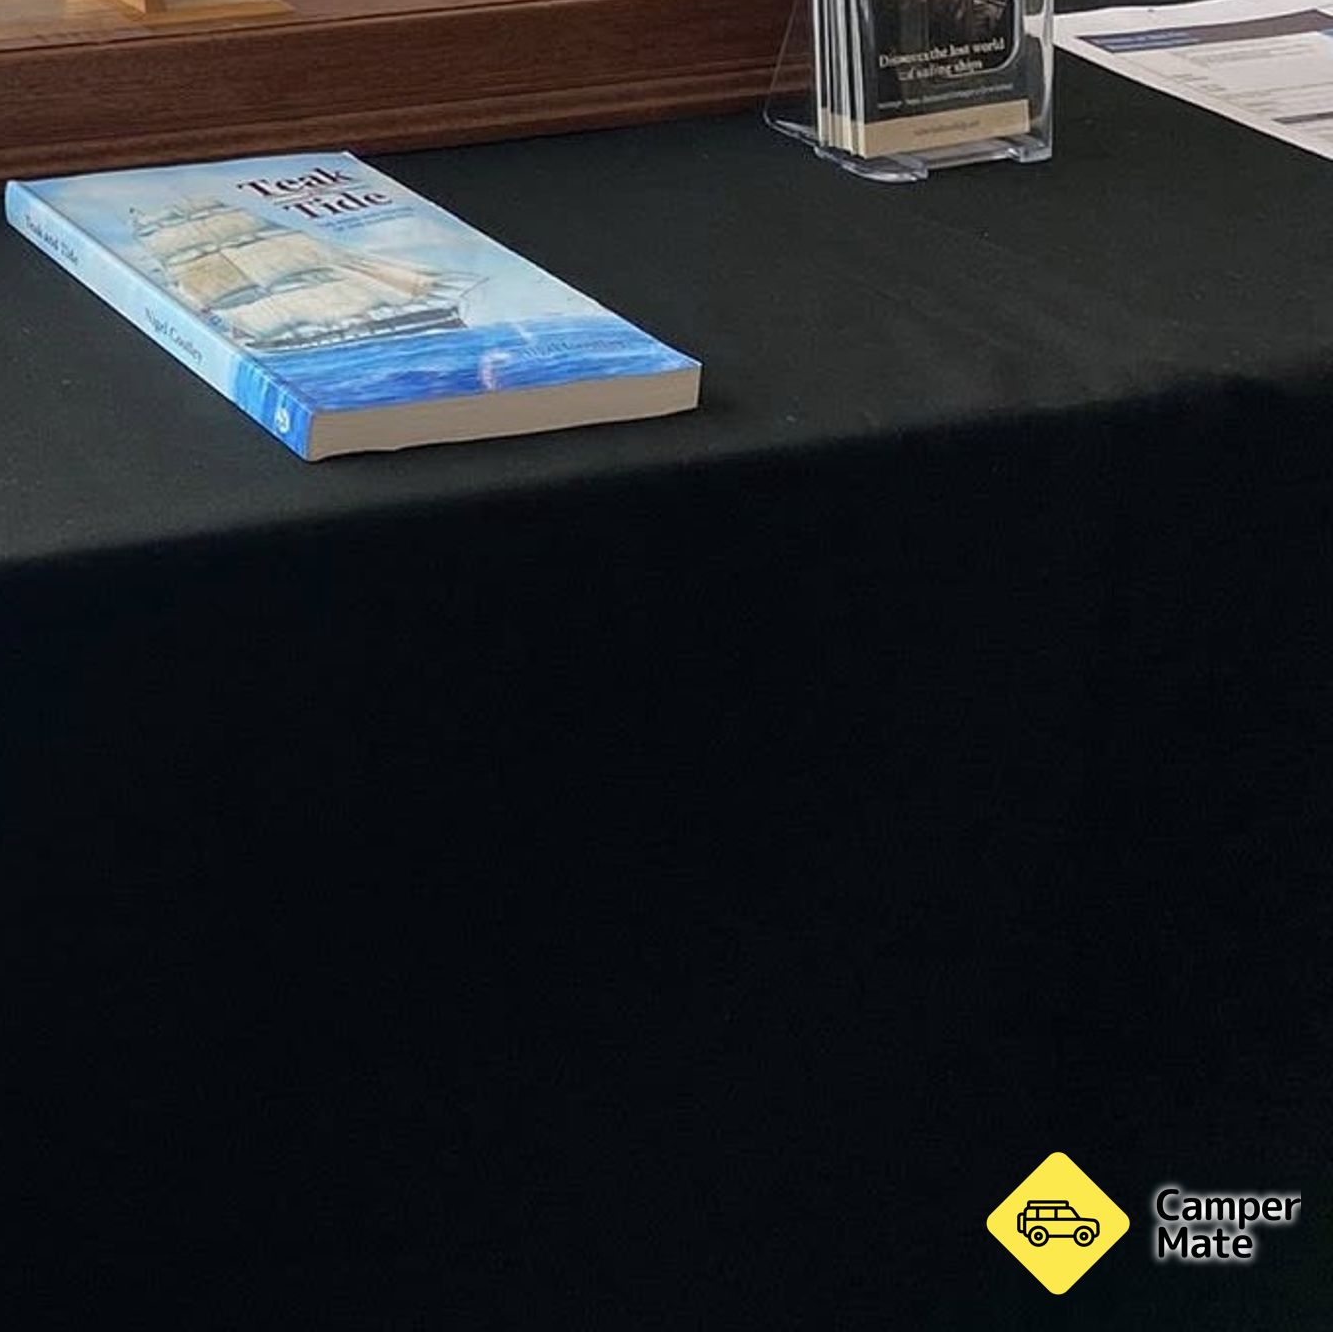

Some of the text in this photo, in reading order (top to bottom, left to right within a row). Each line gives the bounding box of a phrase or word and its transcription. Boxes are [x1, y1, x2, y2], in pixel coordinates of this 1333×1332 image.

[972, 37, 1006, 54] world
[235, 167, 355, 197] Teak
[283, 191, 393, 219] Tide
